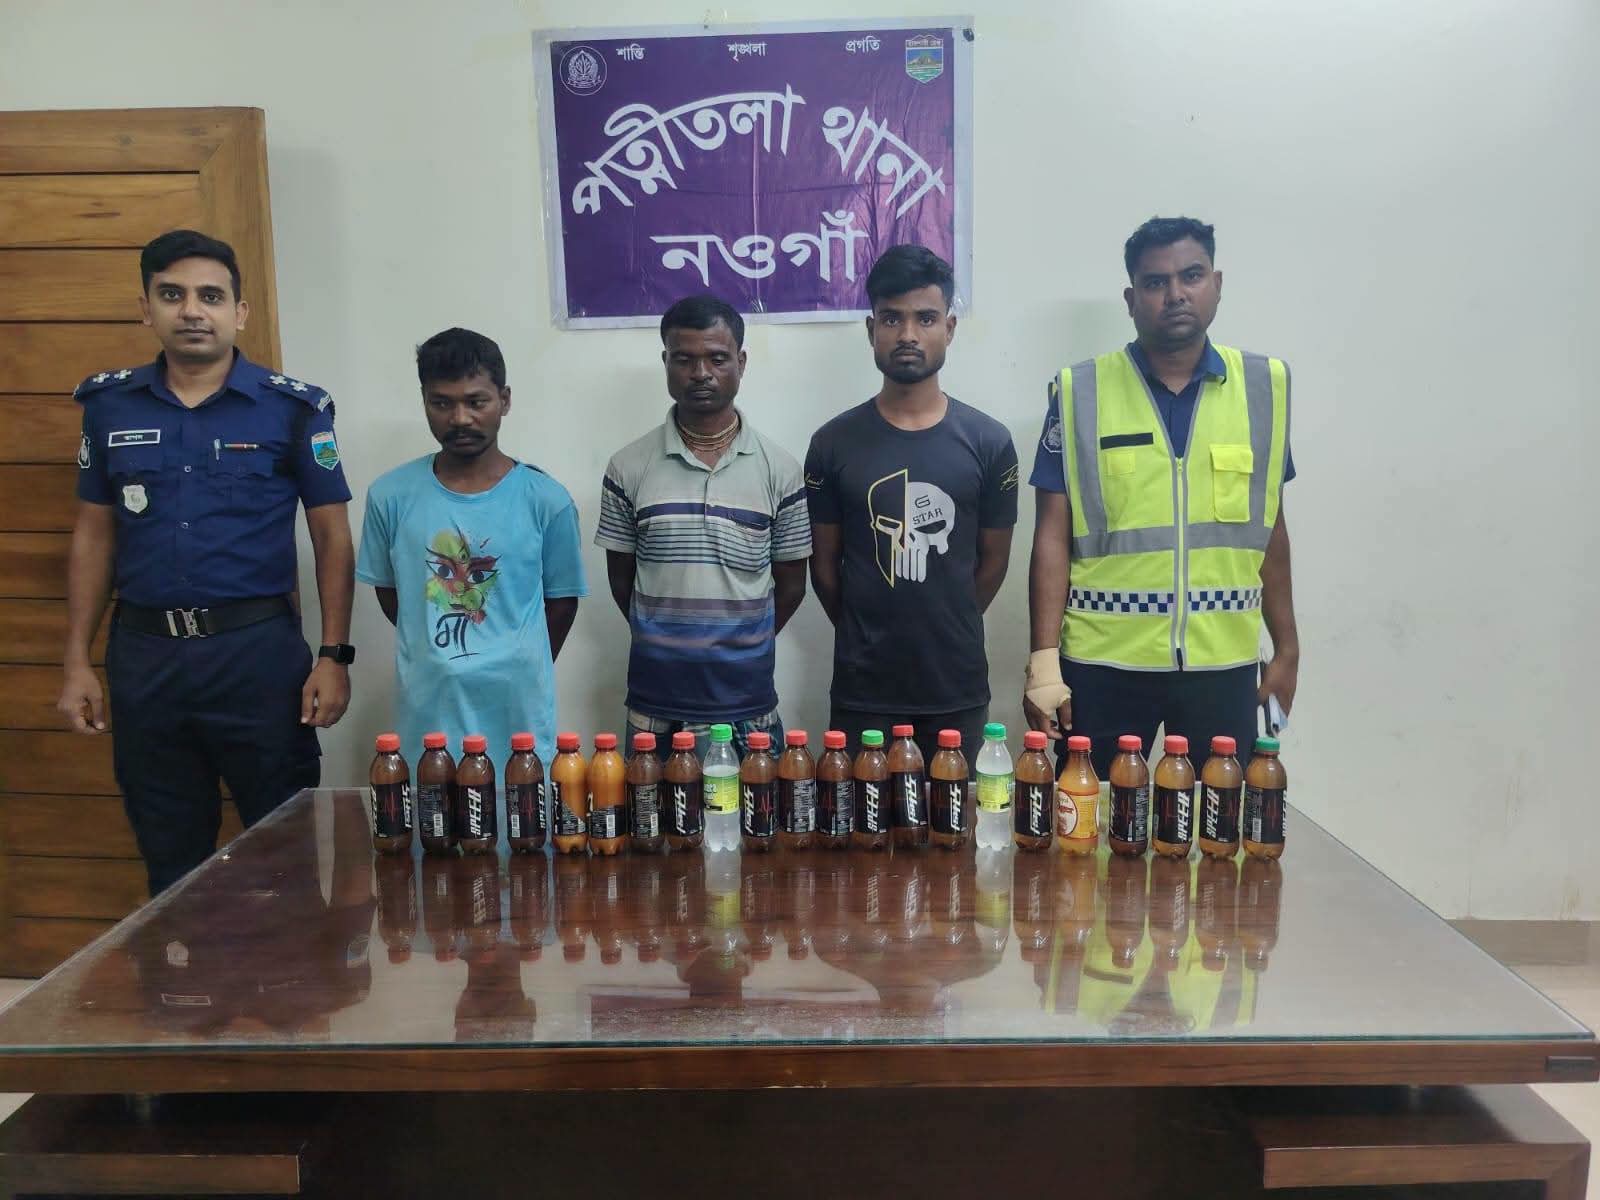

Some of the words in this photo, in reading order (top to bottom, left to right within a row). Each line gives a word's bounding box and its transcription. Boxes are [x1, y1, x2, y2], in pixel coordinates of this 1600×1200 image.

[616, 44, 645, 62] শান্তি
[845, 36, 881, 54] প্রগতি
[572, 84, 806, 215] পত্নীতলা
[822, 106, 946, 219] থানা
[650, 210, 870, 287] নওগাঁ
[912, 507, 943, 526] STAR
[866, 782, 880, 831] SPEED
[1177, 790, 1190, 842] SPEED
[1205, 787, 1220, 839] SPEED
